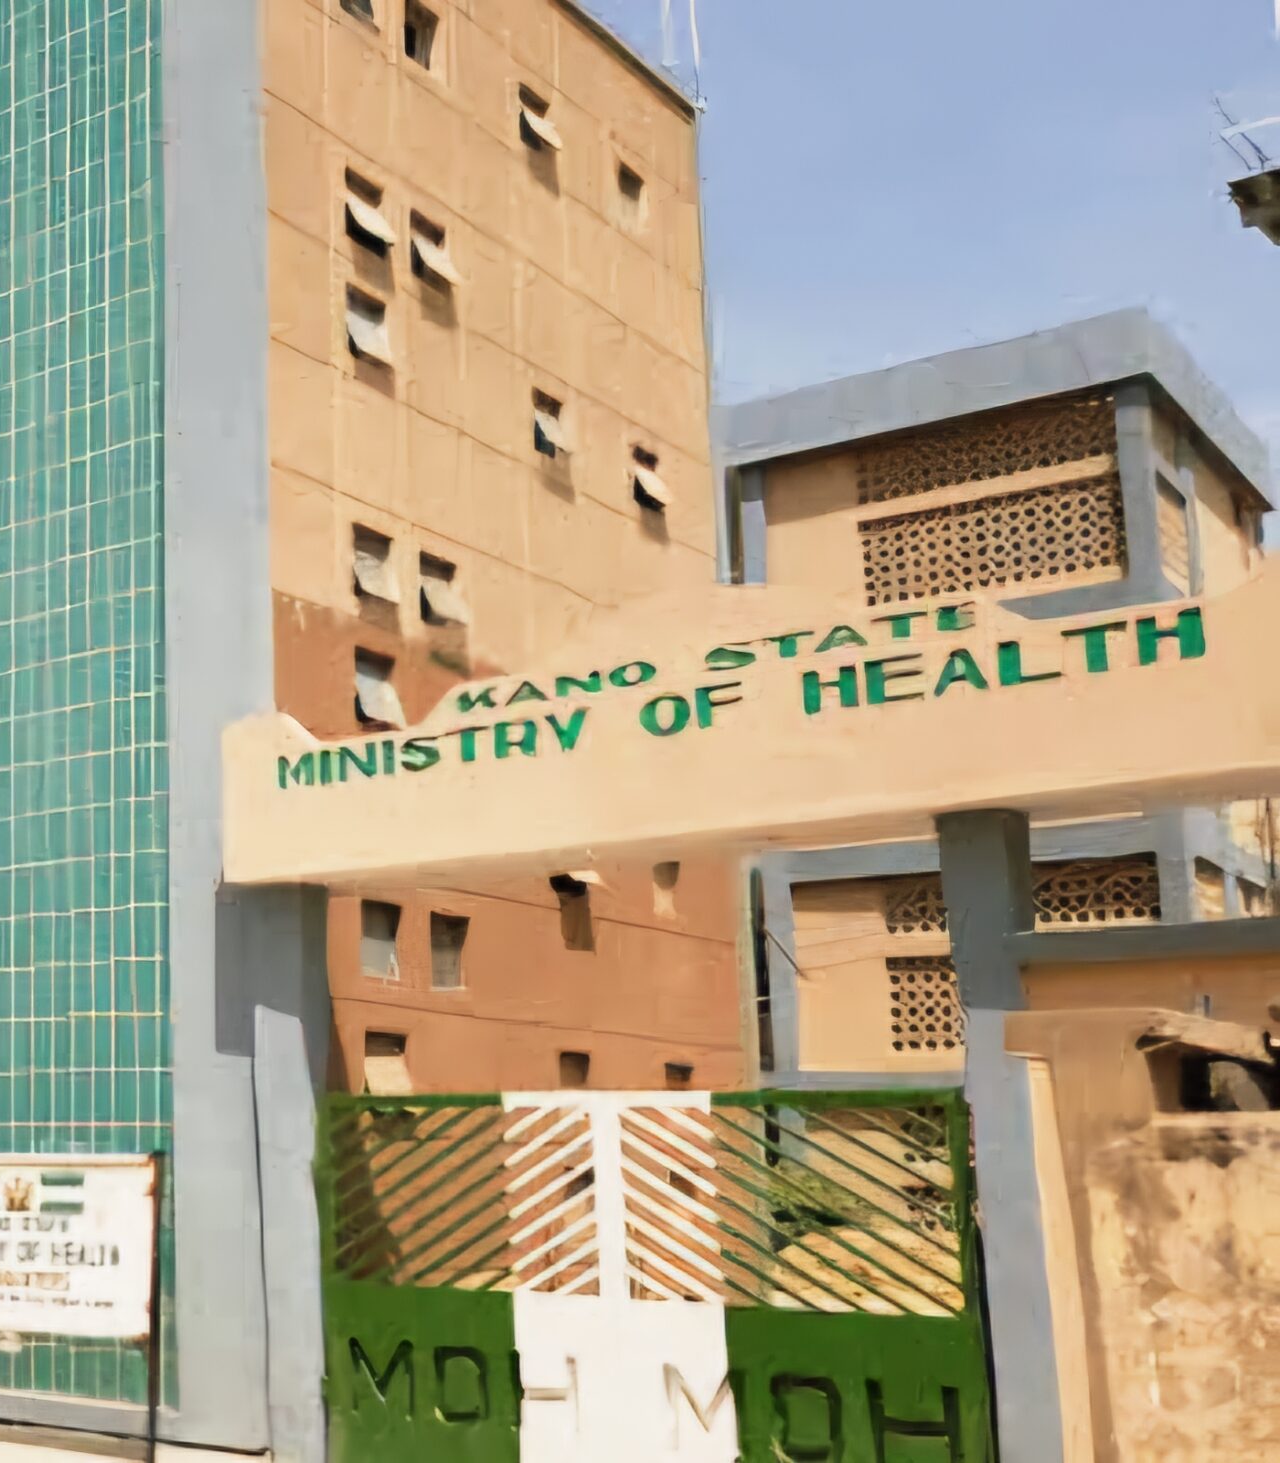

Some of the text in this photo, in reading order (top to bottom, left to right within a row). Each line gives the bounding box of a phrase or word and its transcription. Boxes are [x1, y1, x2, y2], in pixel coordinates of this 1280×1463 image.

[277, 606, 1207, 789] MINISTRY OF HEALTH
[456, 601, 976, 713] KANO STATE
[51, 1242, 120, 1266] HEAL
